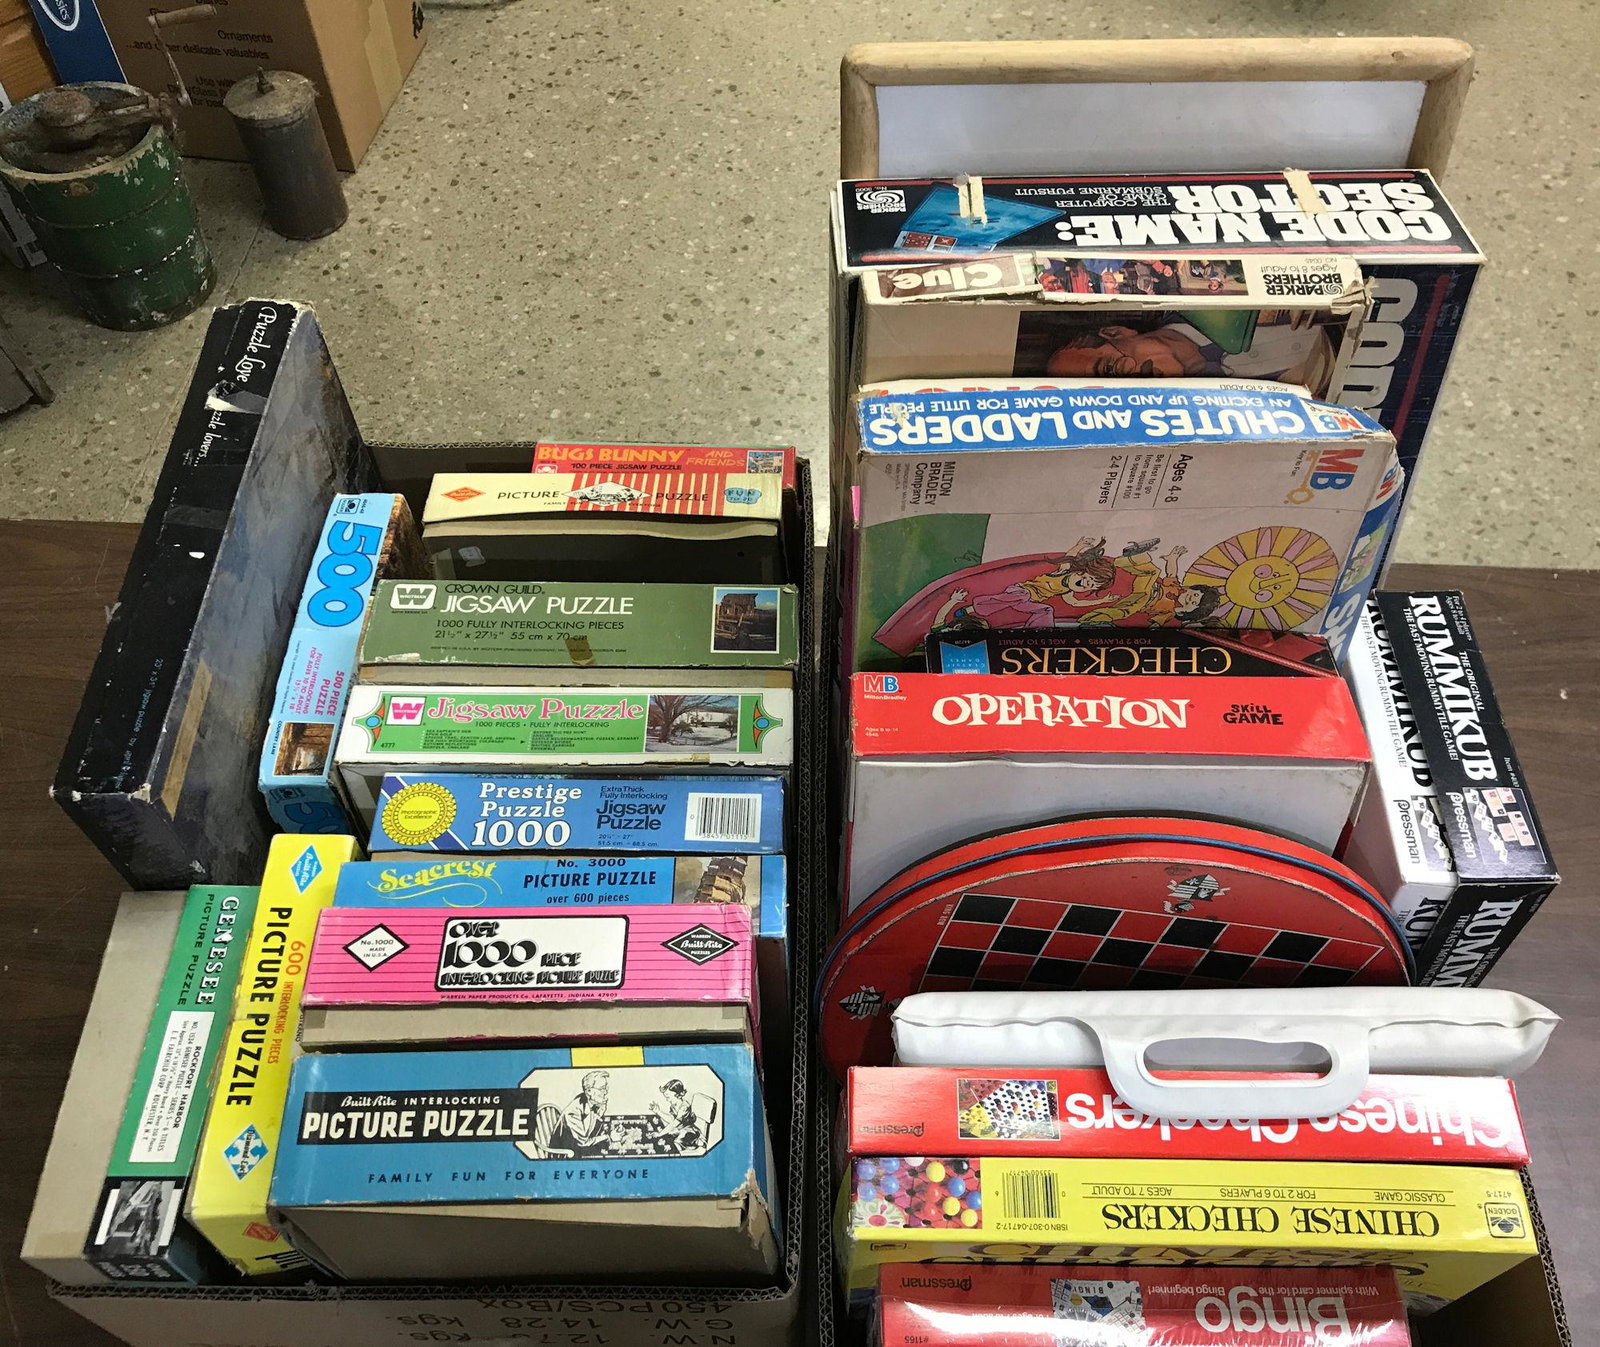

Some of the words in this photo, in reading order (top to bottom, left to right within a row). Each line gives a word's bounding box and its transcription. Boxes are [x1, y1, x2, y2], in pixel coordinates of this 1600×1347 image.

[217, 29, 273, 43] Ornaments
[183, 43, 222, 56] delicate
[223, 48, 270, 59] valuables
[1015, 187, 1074, 196] PURSUIT
[1079, 186, 1163, 195] SUBMARINE
[1121, 192, 1167, 200] GAME
[1168, 182, 1435, 213] SECTOR
[1055, 199, 1138, 208] COMPUTER
[1055, 212, 1270, 247] NAME:
[1273, 211, 1453, 241] CODE
[891, 262, 1003, 291] Clue
[1261, 265, 1287, 273] Adult
[1310, 264, 1338, 273] Ages
[1263, 272, 1342, 285] BROTHERS
[1266, 284, 1325, 296] PARKER
[246, 306, 278, 353] Puzzle
[235, 354, 266, 383] Love
[869, 401, 924, 415] PEOPLE
[930, 399, 971, 411] LITTLE
[977, 398, 1009, 410] FOR
[1014, 396, 1063, 409] GAME
[1070, 394, 1122, 408] DOWN
[1128, 394, 1163, 406] AND
[1170, 394, 1187, 405] UP
[1192, 394, 1265, 407] EXCITING
[1268, 398, 1291, 408] AN
[1073, 408, 1132, 430] AND
[1140, 408, 1306, 437] CHUTES
[1321, 415, 1363, 431] MB
[869, 411, 1068, 446] LADDERS
[538, 446, 594, 461] BUGS
[598, 447, 685, 462] BUNNY
[685, 457, 745, 467] FRIENDS
[1171, 453, 1194, 482] Ages
[1309, 448, 1366, 491] MB
[911, 462, 928, 506] Company
[925, 462, 942, 506] BRADLEY
[939, 461, 956, 497] MILTON
[497, 490, 560, 500] PICTURE
[1098, 471, 1118, 505] Players
[1164, 485, 1182, 503] 4-8
[655, 492, 709, 502] PUZZLE
[307, 519, 383, 628] 500
[444, 583, 500, 594] CROWN
[440, 595, 537, 614] JIGSAW
[546, 596, 635, 615] PUZZLE
[1403, 607, 1414, 623] THE
[436, 619, 464, 628] 1000
[466, 620, 498, 629] FULLY
[500, 620, 585, 630] INTERLOCKING
[588, 621, 625, 630] PIECES
[1408, 620, 1421, 645] FAST
[1088, 638, 1124, 646] PLAYERS
[1364, 628, 1377, 651] FAST
[1000, 646, 1232, 675] CHECKERS
[1370, 650, 1386, 686] MOVING
[1415, 643, 1433, 677] MOVING
[334, 670, 345, 691] 500
[863, 674, 900, 693] MB
[1408, 595, 1499, 781] RUMMIKUB
[1458, 650, 1469, 668] THE
[1466, 666, 1485, 712] ORIGINAL
[302, 668, 319, 715] INTERLOCKING
[314, 678, 331, 716] PUZZLE
[1424, 674, 1443, 713] RUMMY
[327, 690, 342, 716] PIECE
[427, 696, 536, 724] Jigsaw
[538, 697, 644, 721] Puzzle
[931, 691, 1191, 728] OPERATION
[1379, 684, 1395, 719] RUMMY
[1223, 711, 1284, 726] GAME
[1437, 711, 1449, 728] TILE
[1388, 718, 1400, 737] TILE
[1441, 727, 1459, 761] GAME!
[478, 782, 583, 805] Prestige
[599, 792, 619, 800] Fully
[620, 792, 668, 801] Interlocking
[600, 785, 622, 793] Extra
[623, 785, 645, 793] Thick
[479, 801, 566, 818] Puzzle
[596, 799, 667, 818] Jigsaw
[596, 814, 662, 831] Puzzle
[470, 819, 572, 848] 1000
[556, 858, 579, 868] No.
[587, 857, 626, 867] 3000
[377, 859, 498, 893] Seacrest
[523, 872, 590, 889] PICTURE
[597, 870, 657, 886] PUZZLE
[546, 895, 570, 904] over
[573, 892, 594, 903] 600
[598, 892, 630, 904] pieces
[194, 893, 215, 949] PICTURE
[194, 895, 240, 1005] GENESEE
[250, 906, 294, 1003] PICTURE
[285, 940, 306, 976] 600
[443, 939, 538, 969] 1000
[540, 952, 582, 967] PIECE
[177, 954, 200, 1006] PUZZLE
[439, 971, 536, 987] INTERLOCKING
[536, 970, 584, 985] PICTURE
[584, 969, 620, 984] PUZZLE
[273, 981, 295, 1034] INTERLOCKING
[226, 1013, 271, 1106] PUZZLE
[267, 1038, 283, 1064] PIECES
[184, 1045, 202, 1090] ROCKPORT
[404, 1095, 501, 1106] INTERLOCKING
[173, 1093, 188, 1129] HARBOR
[302, 1110, 416, 1140] PICTURE
[422, 1108, 530, 1137] PUZZLE
[368, 1172, 433, 1184] FAMILY
[451, 1171, 487, 1182] FUN
[505, 1170, 537, 1182] FOR
[554, 1168, 650, 1180] EVERYONE
[1091, 1187, 1121, 1196] ADULT
[1122, 1187, 1137, 1196] TO
[1145, 1187, 1173, 1196] AGES
[1220, 1188, 1264, 1200] PLAYERS
[1273, 1189, 1286, 1199] TO
[1296, 1189, 1317, 1200] FOR
[1374, 1191, 1402, 1202] GAME
[1402, 1191, 1446, 1203] CLASSIC
[1486, 1190, 1512, 1198] 4717-5
[1101, 1203, 1281, 1234] CHECKERS
[1487, 1207, 1518, 1215] GOLDEN
[995, 1222, 1051, 1231] 0-307-04717-2
[1051, 1223, 1069, 1231] ISBN
[1292, 1205, 1440, 1237] CHINESE
[1148, 1285, 1195, 1297] beginner!
[1195, 1285, 1226, 1298] Bingo
[1275, 1286, 1292, 1296] for
[1292, 1286, 1314, 1296] card
[1316, 1285, 1354, 1298] spinner
[1354, 1286, 1380, 1296] With
[385, 1313, 462, 1329] kgs.
[500, 1316, 601, 1330] 14.28
[1195, 1284, 1352, 1346] Bingo
[643, 1317, 734, 1331] G.W.
[397, 1330, 472, 1345] kgs.
[649, 1333, 736, 1345] N.W.
